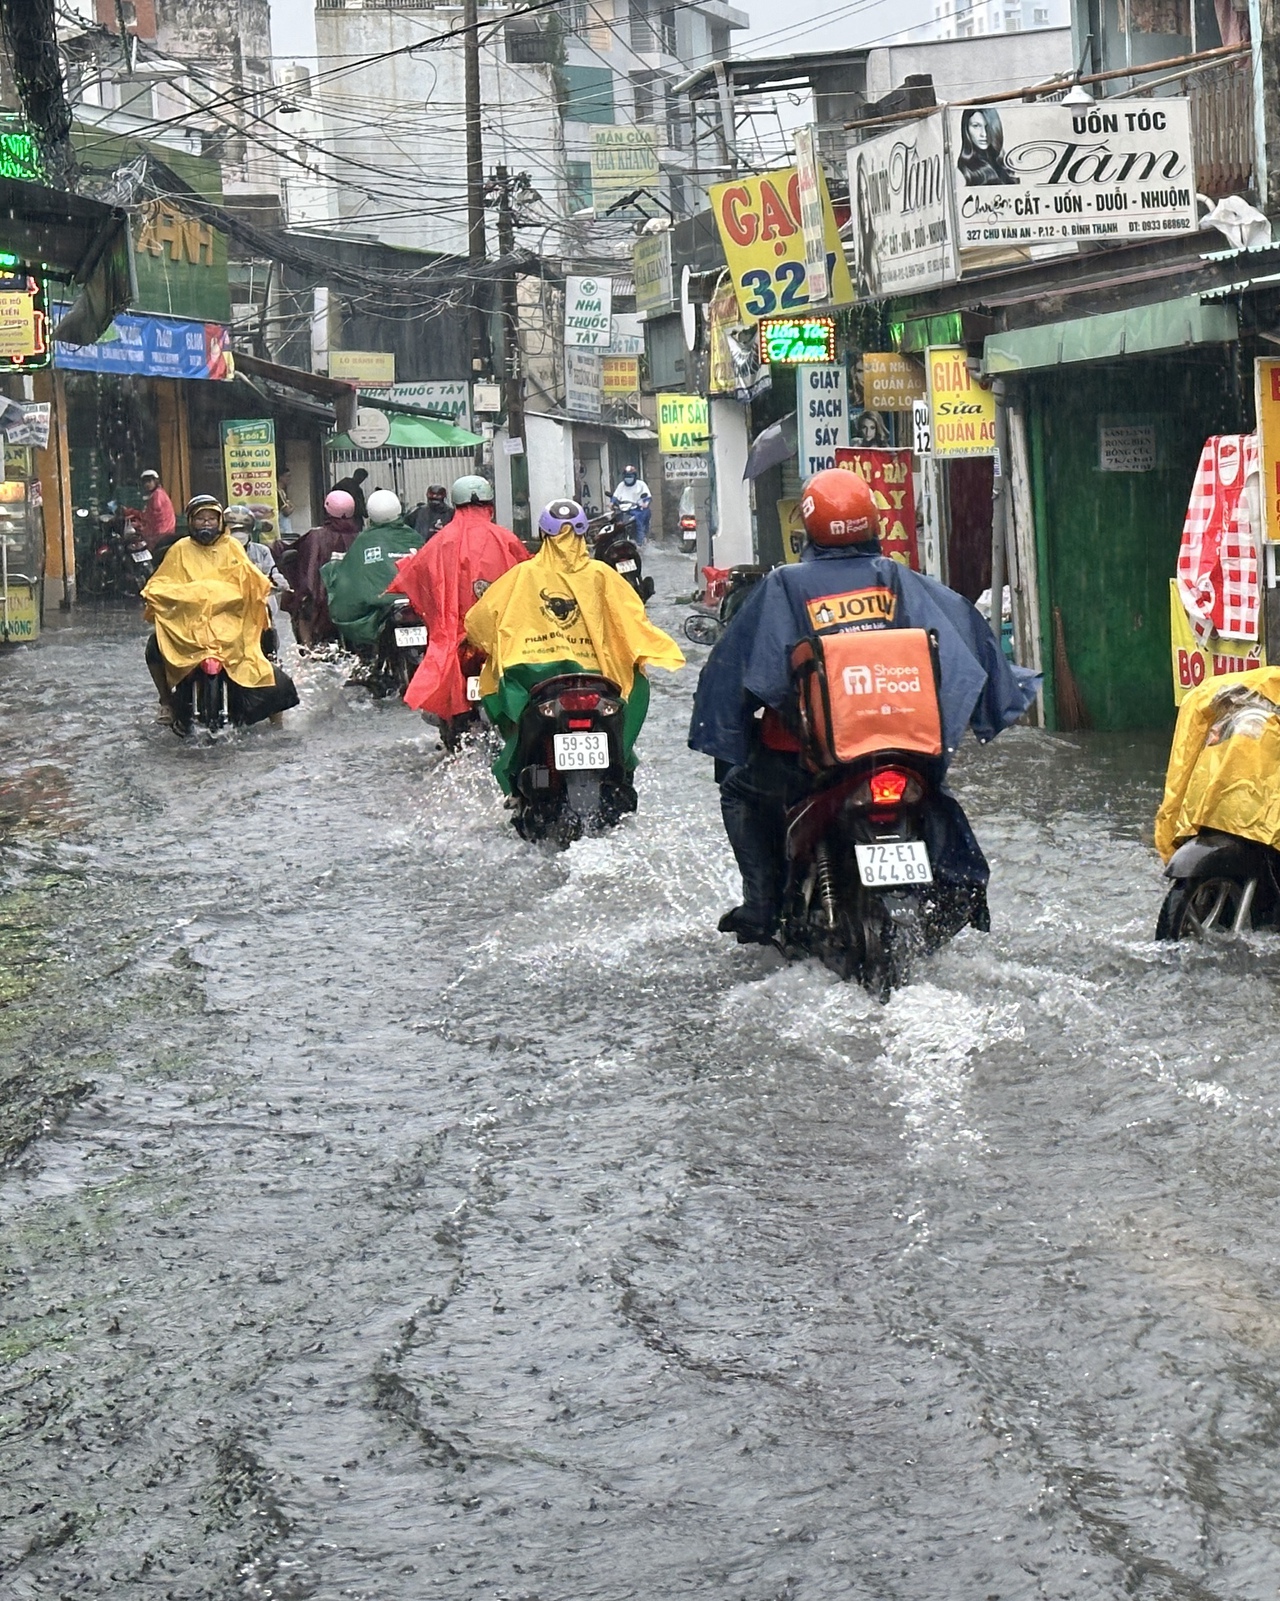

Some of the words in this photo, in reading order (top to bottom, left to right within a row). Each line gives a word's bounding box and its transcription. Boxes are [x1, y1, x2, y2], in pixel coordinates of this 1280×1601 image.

[1073, 107, 1118, 135] UỐN
[1125, 109, 1167, 131] TÓC
[1004, 138, 1187, 186] Tâm
[889, 137, 944, 214] Tâm
[1014, 191, 1040, 216] CẮT
[1054, 189, 1082, 214] UỐN
[1096, 187, 1128, 212] DUỖI
[1141, 186, 1190, 211] NHUỘM
[966, 229, 981, 241] 327
[983, 228, 1000, 239] CHU
[1020, 226, 1031, 238] AN
[1038, 226, 1055, 237] P.12
[1072, 223, 1091, 235] BÌNH
[1092, 223, 1118, 237] THẠNH
[1142, 220, 1161, 231] 0933
[575, 298, 602, 311] NHÀ
[567, 313, 608, 328] THUỐC
[576, 330, 598, 343] TÂY
[393, 384, 434, 396] THUỐC
[439, 385, 464, 395] TÂY
[661, 400, 684, 429] GIẶT
[809, 399, 842, 422] SẠCH
[937, 401, 983, 416] Sửa
[915, 409, 928, 430] QU
[815, 422, 839, 446] SẤY
[936, 416, 975, 444] QUẦN
[232, 482, 253, 497] 39
[874, 664, 919, 678] Shopee
[876, 676, 921, 693] Food
[562, 737, 600, 751] 59-S3
[866, 845, 916, 863] 72-E1
[864, 863, 927, 883] 844.89
